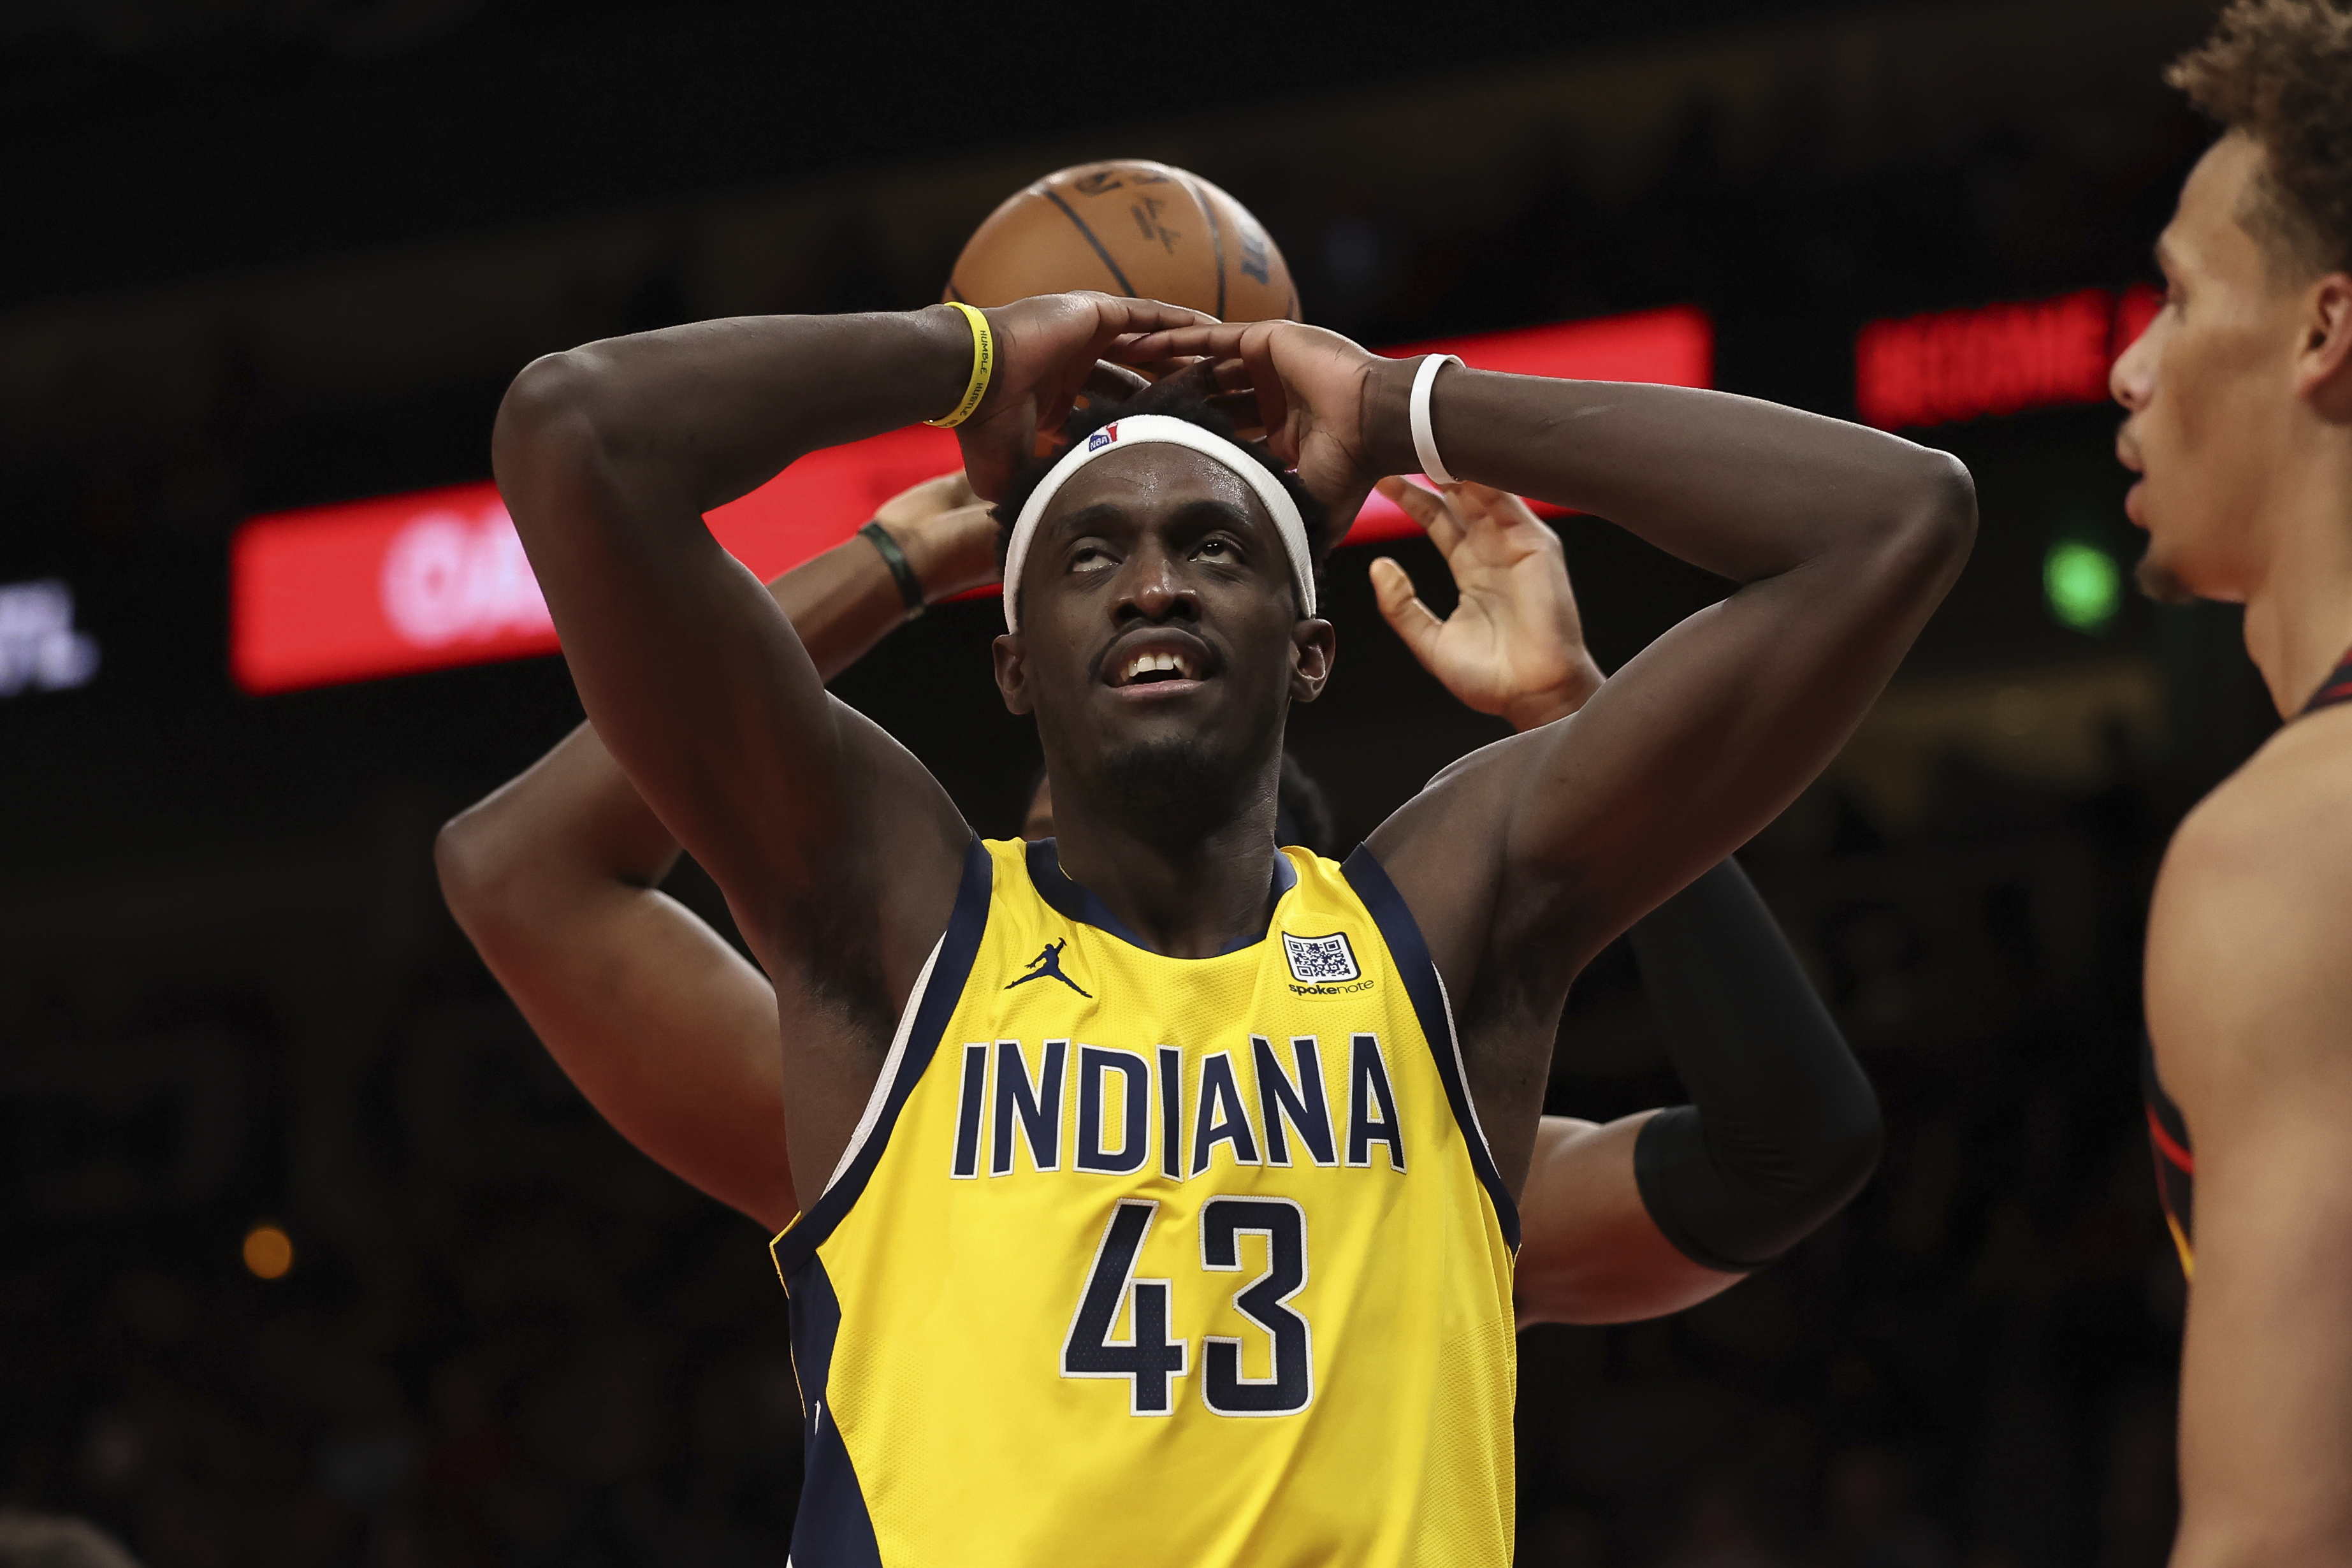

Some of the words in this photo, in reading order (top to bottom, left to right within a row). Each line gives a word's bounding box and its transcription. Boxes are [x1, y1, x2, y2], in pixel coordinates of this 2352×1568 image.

[980, 330, 989, 374] HUMBLE
[1090, 436, 1108, 450] NBA
[1288, 980, 1374, 996] spokenote
[950, 1032, 1407, 1182] INDIANA
[1059, 1194, 1314, 1417] 43
